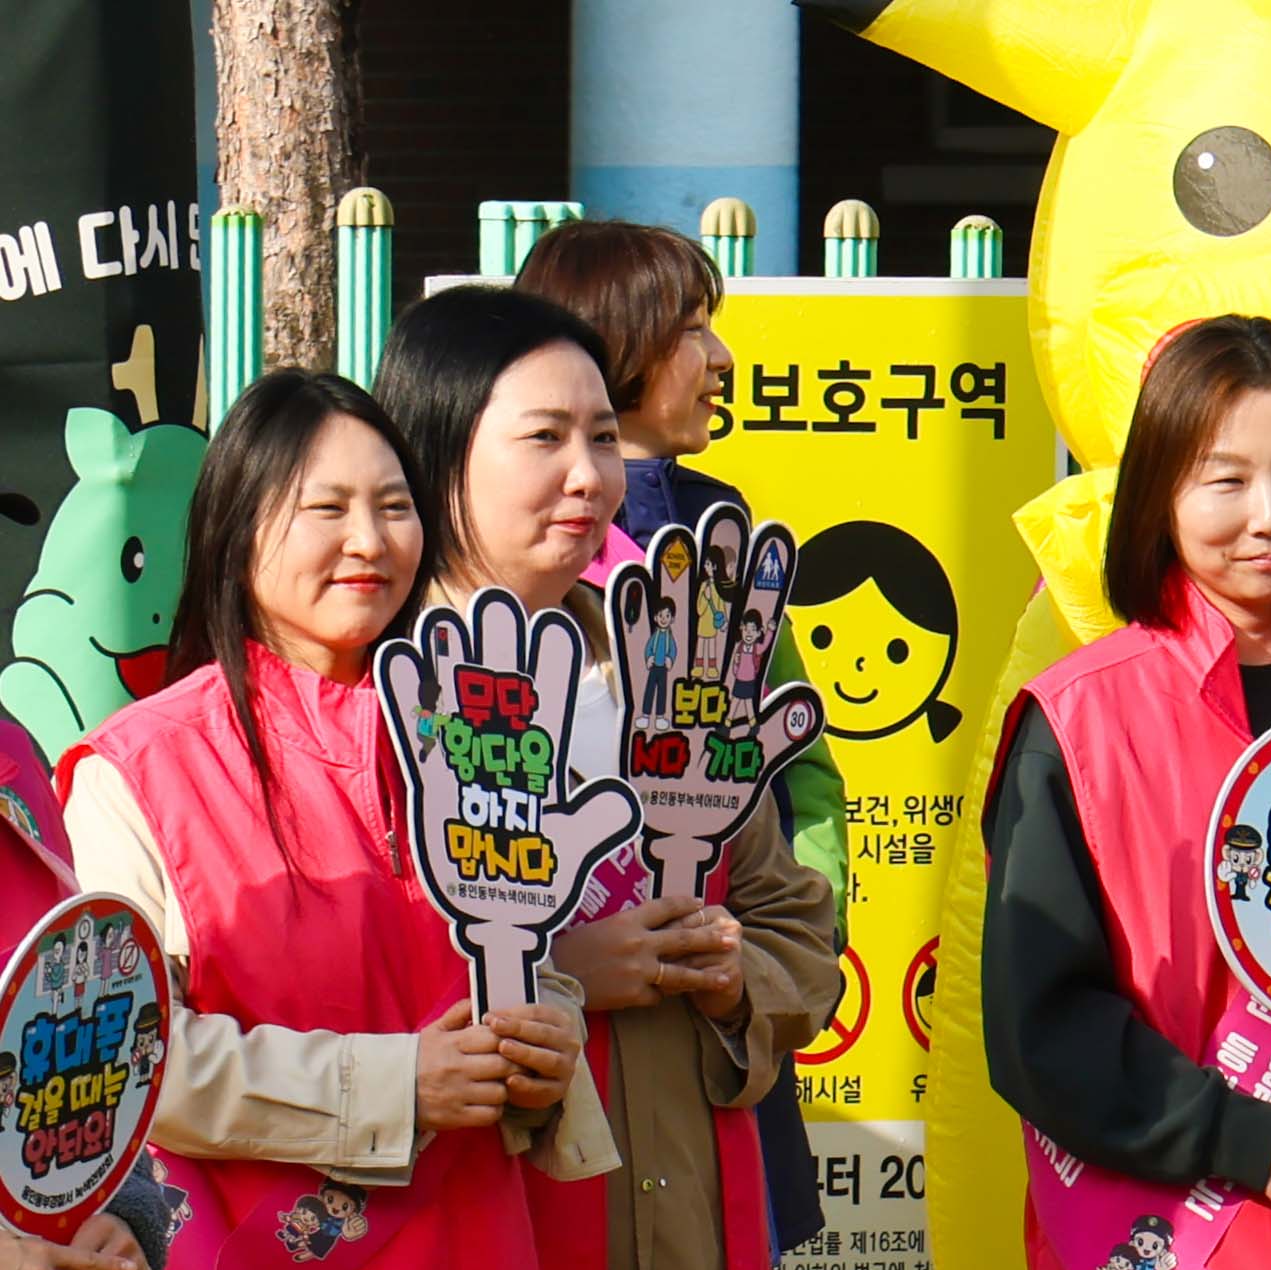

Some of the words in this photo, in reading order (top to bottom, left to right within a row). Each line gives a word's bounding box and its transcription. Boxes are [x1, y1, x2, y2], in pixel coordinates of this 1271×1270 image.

[78, 199, 179, 280] 다시
[456, 668, 539, 731] 무단
[674, 683, 728, 724] 보다
[790, 711, 806, 728] 30
[443, 722, 554, 794] 횡단을
[707, 736, 761, 778] 가다
[460, 784, 538, 833] 하지
[902, 794, 965, 827] 위생
[857, 832, 936, 865] 시설을
[458, 883, 556, 908] 용인동부녹색어머니회
[21, 994, 133, 1087] 휴대폰
[18, 1074, 65, 1130] 걸을
[69, 1062, 129, 1114] 때는
[850, 1230, 925, 1255] 제16조에
